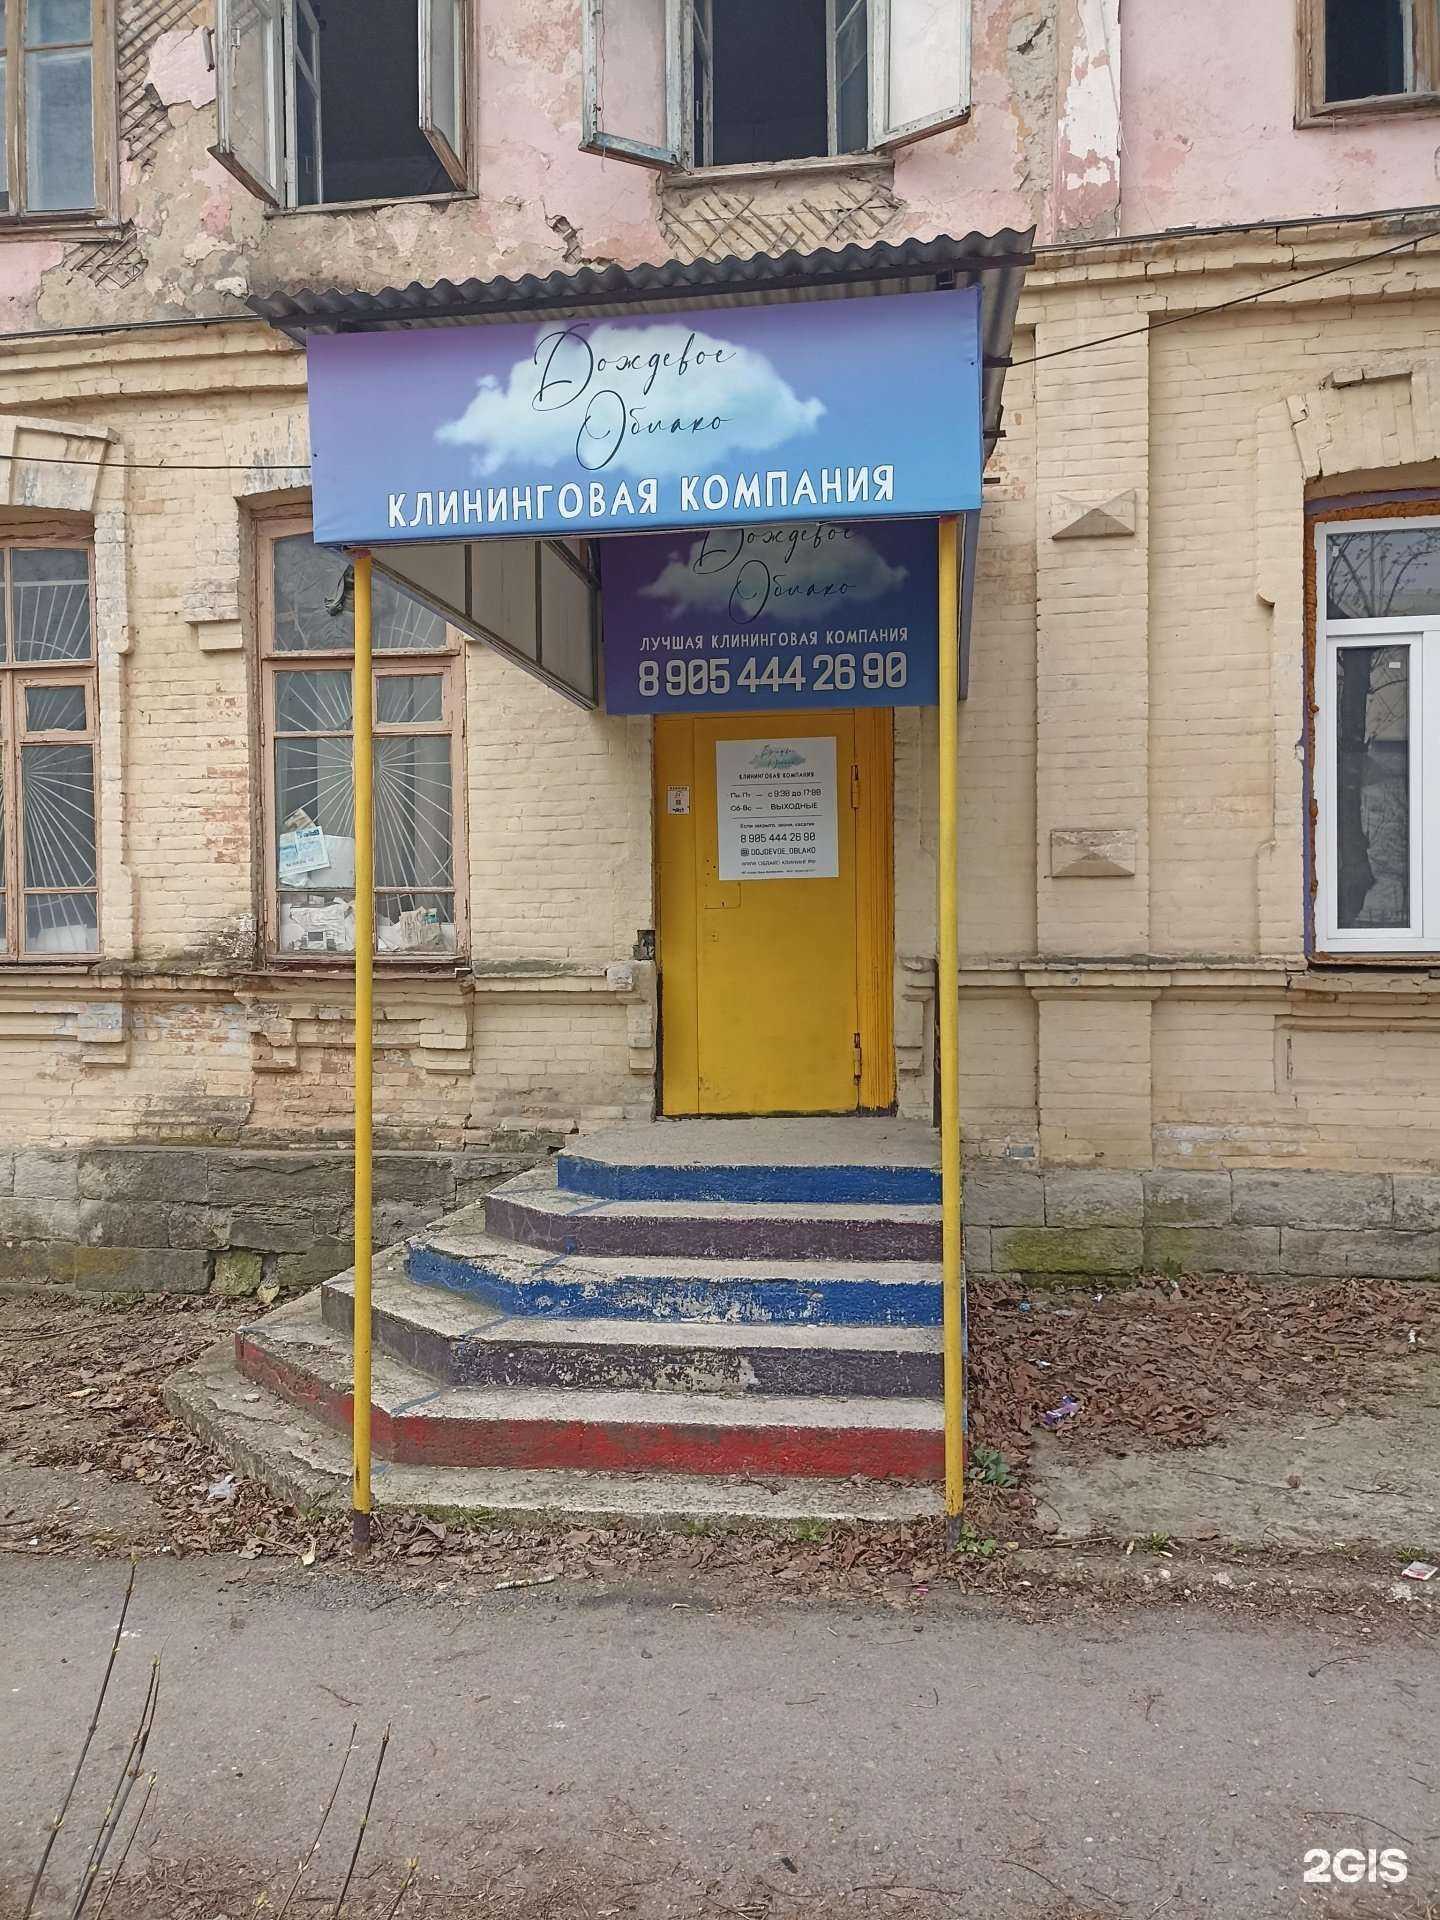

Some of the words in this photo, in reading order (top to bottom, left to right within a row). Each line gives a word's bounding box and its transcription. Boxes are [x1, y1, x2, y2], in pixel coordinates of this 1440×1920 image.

[531, 322, 737, 411] Дождевое
[576, 390, 734, 471] Облако
[388, 478, 658, 528] КЛИНИНГОВАЯ
[681, 465, 895, 513] КОМПАНИЯ
[729, 560, 856, 624] Облако
[640, 634, 703, 651] ЛУЧШАЯ
[711, 631, 818, 648] КЛИНИНГОВАЯ
[826, 627, 908, 645] КОМПАНИЯ
[638, 660, 660, 697] 8
[666, 658, 730, 695] 905
[737, 656, 806, 692] 444
[813, 654, 856, 690] 26
[863, 651, 907, 688] 90
[770, 802, 819, 811] ВЫХОДНЫЕ
[740, 835, 747, 843] 8
[748, 834, 767, 843] 905
[769, 833, 788, 842] 444
[789, 832, 802, 842] 26
[803, 832, 816, 841] 90
